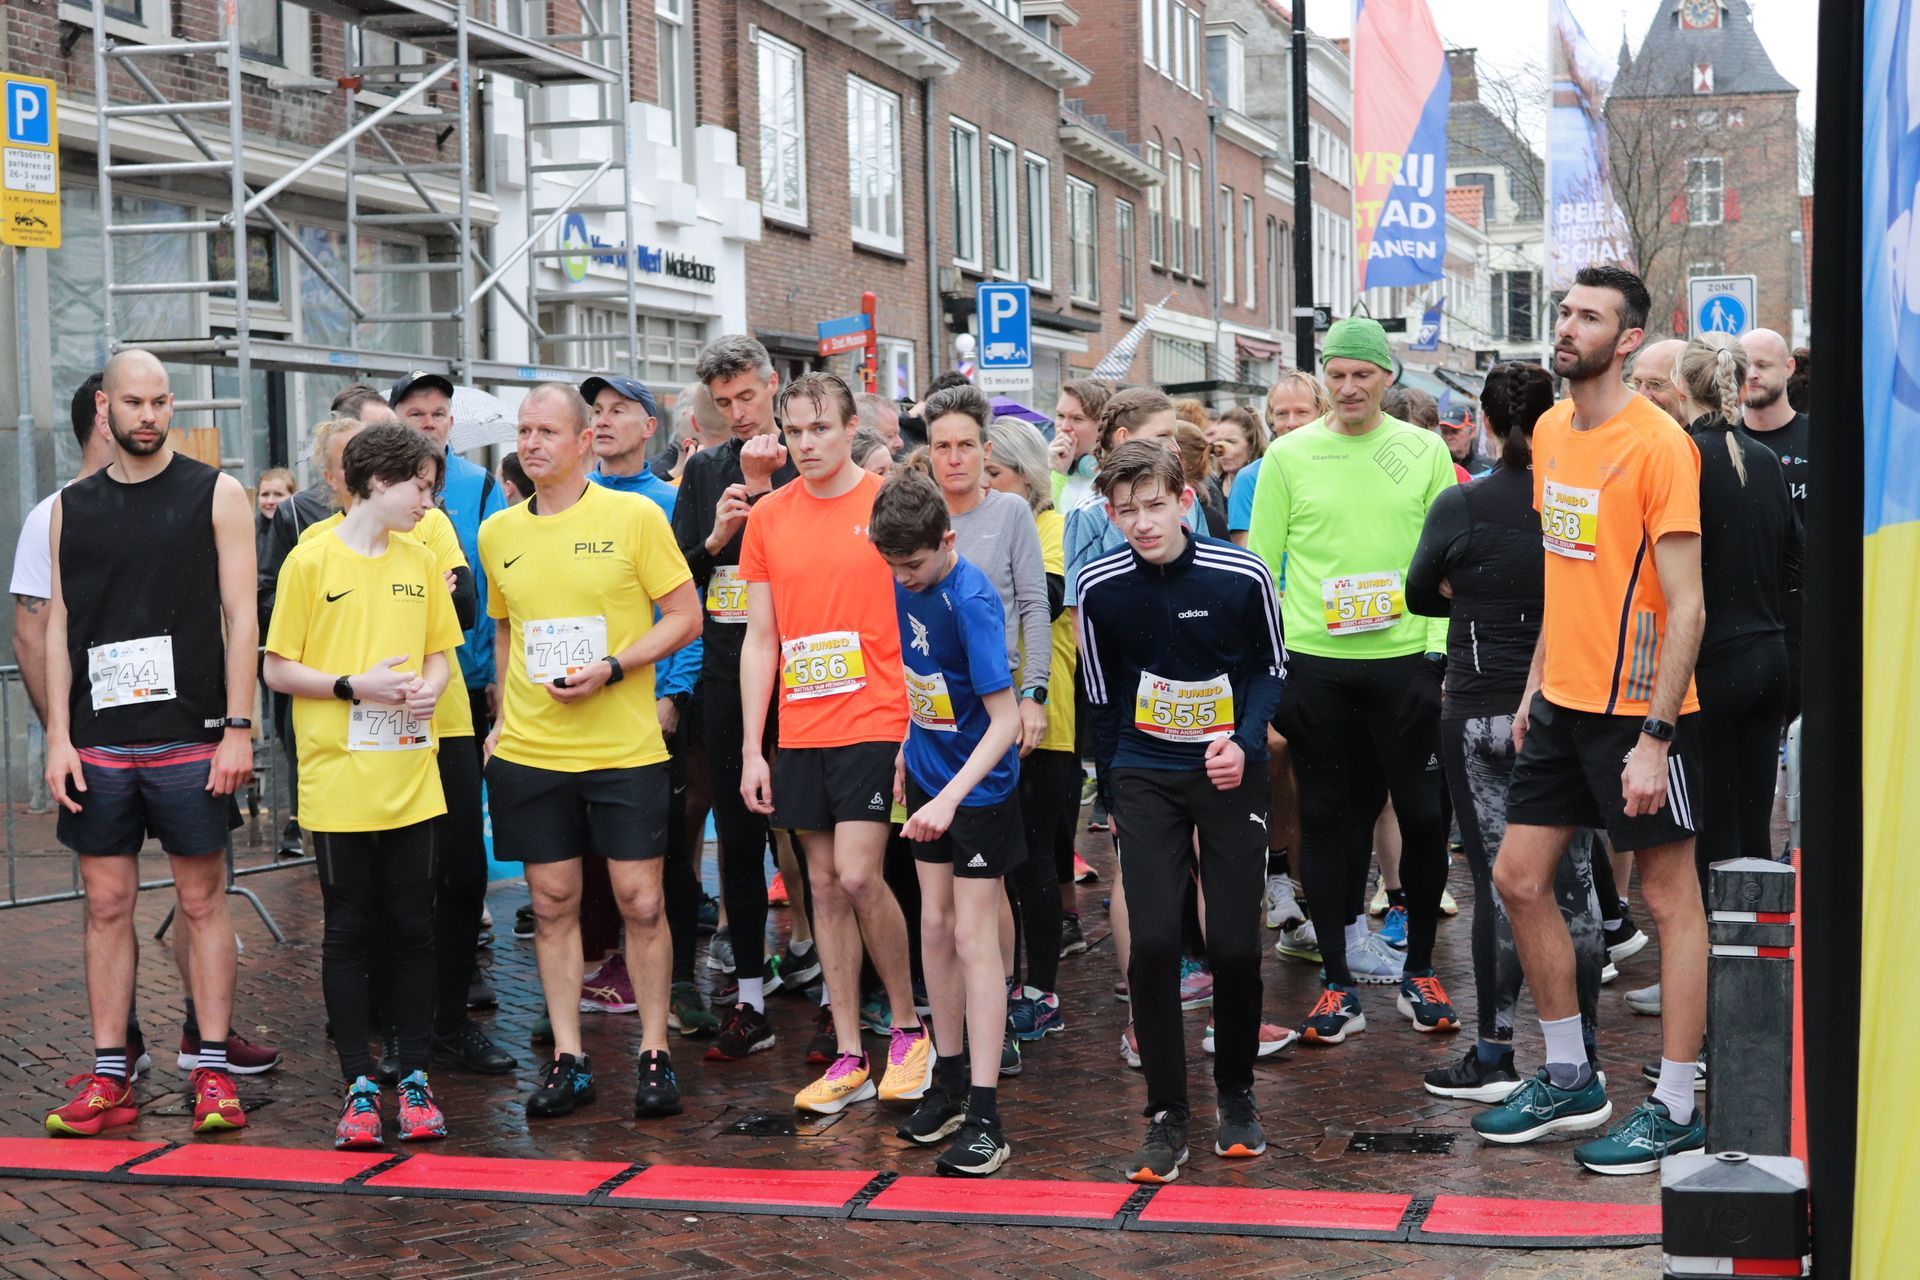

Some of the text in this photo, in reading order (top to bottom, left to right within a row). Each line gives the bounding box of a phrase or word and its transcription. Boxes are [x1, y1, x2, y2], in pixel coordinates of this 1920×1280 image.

[16, 89, 40, 136] P
[9, 149, 42, 160] verboden
[9, 159, 51, 172] parkeren op
[1353, 151, 1434, 198] VRIJ
[1708, 282, 1736, 292] ZONE
[990, 292, 1018, 334] P
[1556, 492, 1589, 508] JUMBO
[1542, 506, 1580, 540] 558
[574, 541, 614, 554] PILZ
[392, 584, 425, 598] PILZ
[1358, 578, 1392, 590] JUMBO
[717, 586, 748, 609] 57
[1338, 592, 1392, 620] 576
[1178, 609, 1208, 618] adidas
[536, 639, 593, 667] 714
[810, 638, 850, 652] JUMBO
[101, 660, 158, 691] 744
[795, 654, 848, 684] 566
[1177, 686, 1223, 698] JUMBO
[366, 710, 421, 735] 715
[1152, 700, 1216, 728] 555
[1180, 728, 1204, 736] ANSING
